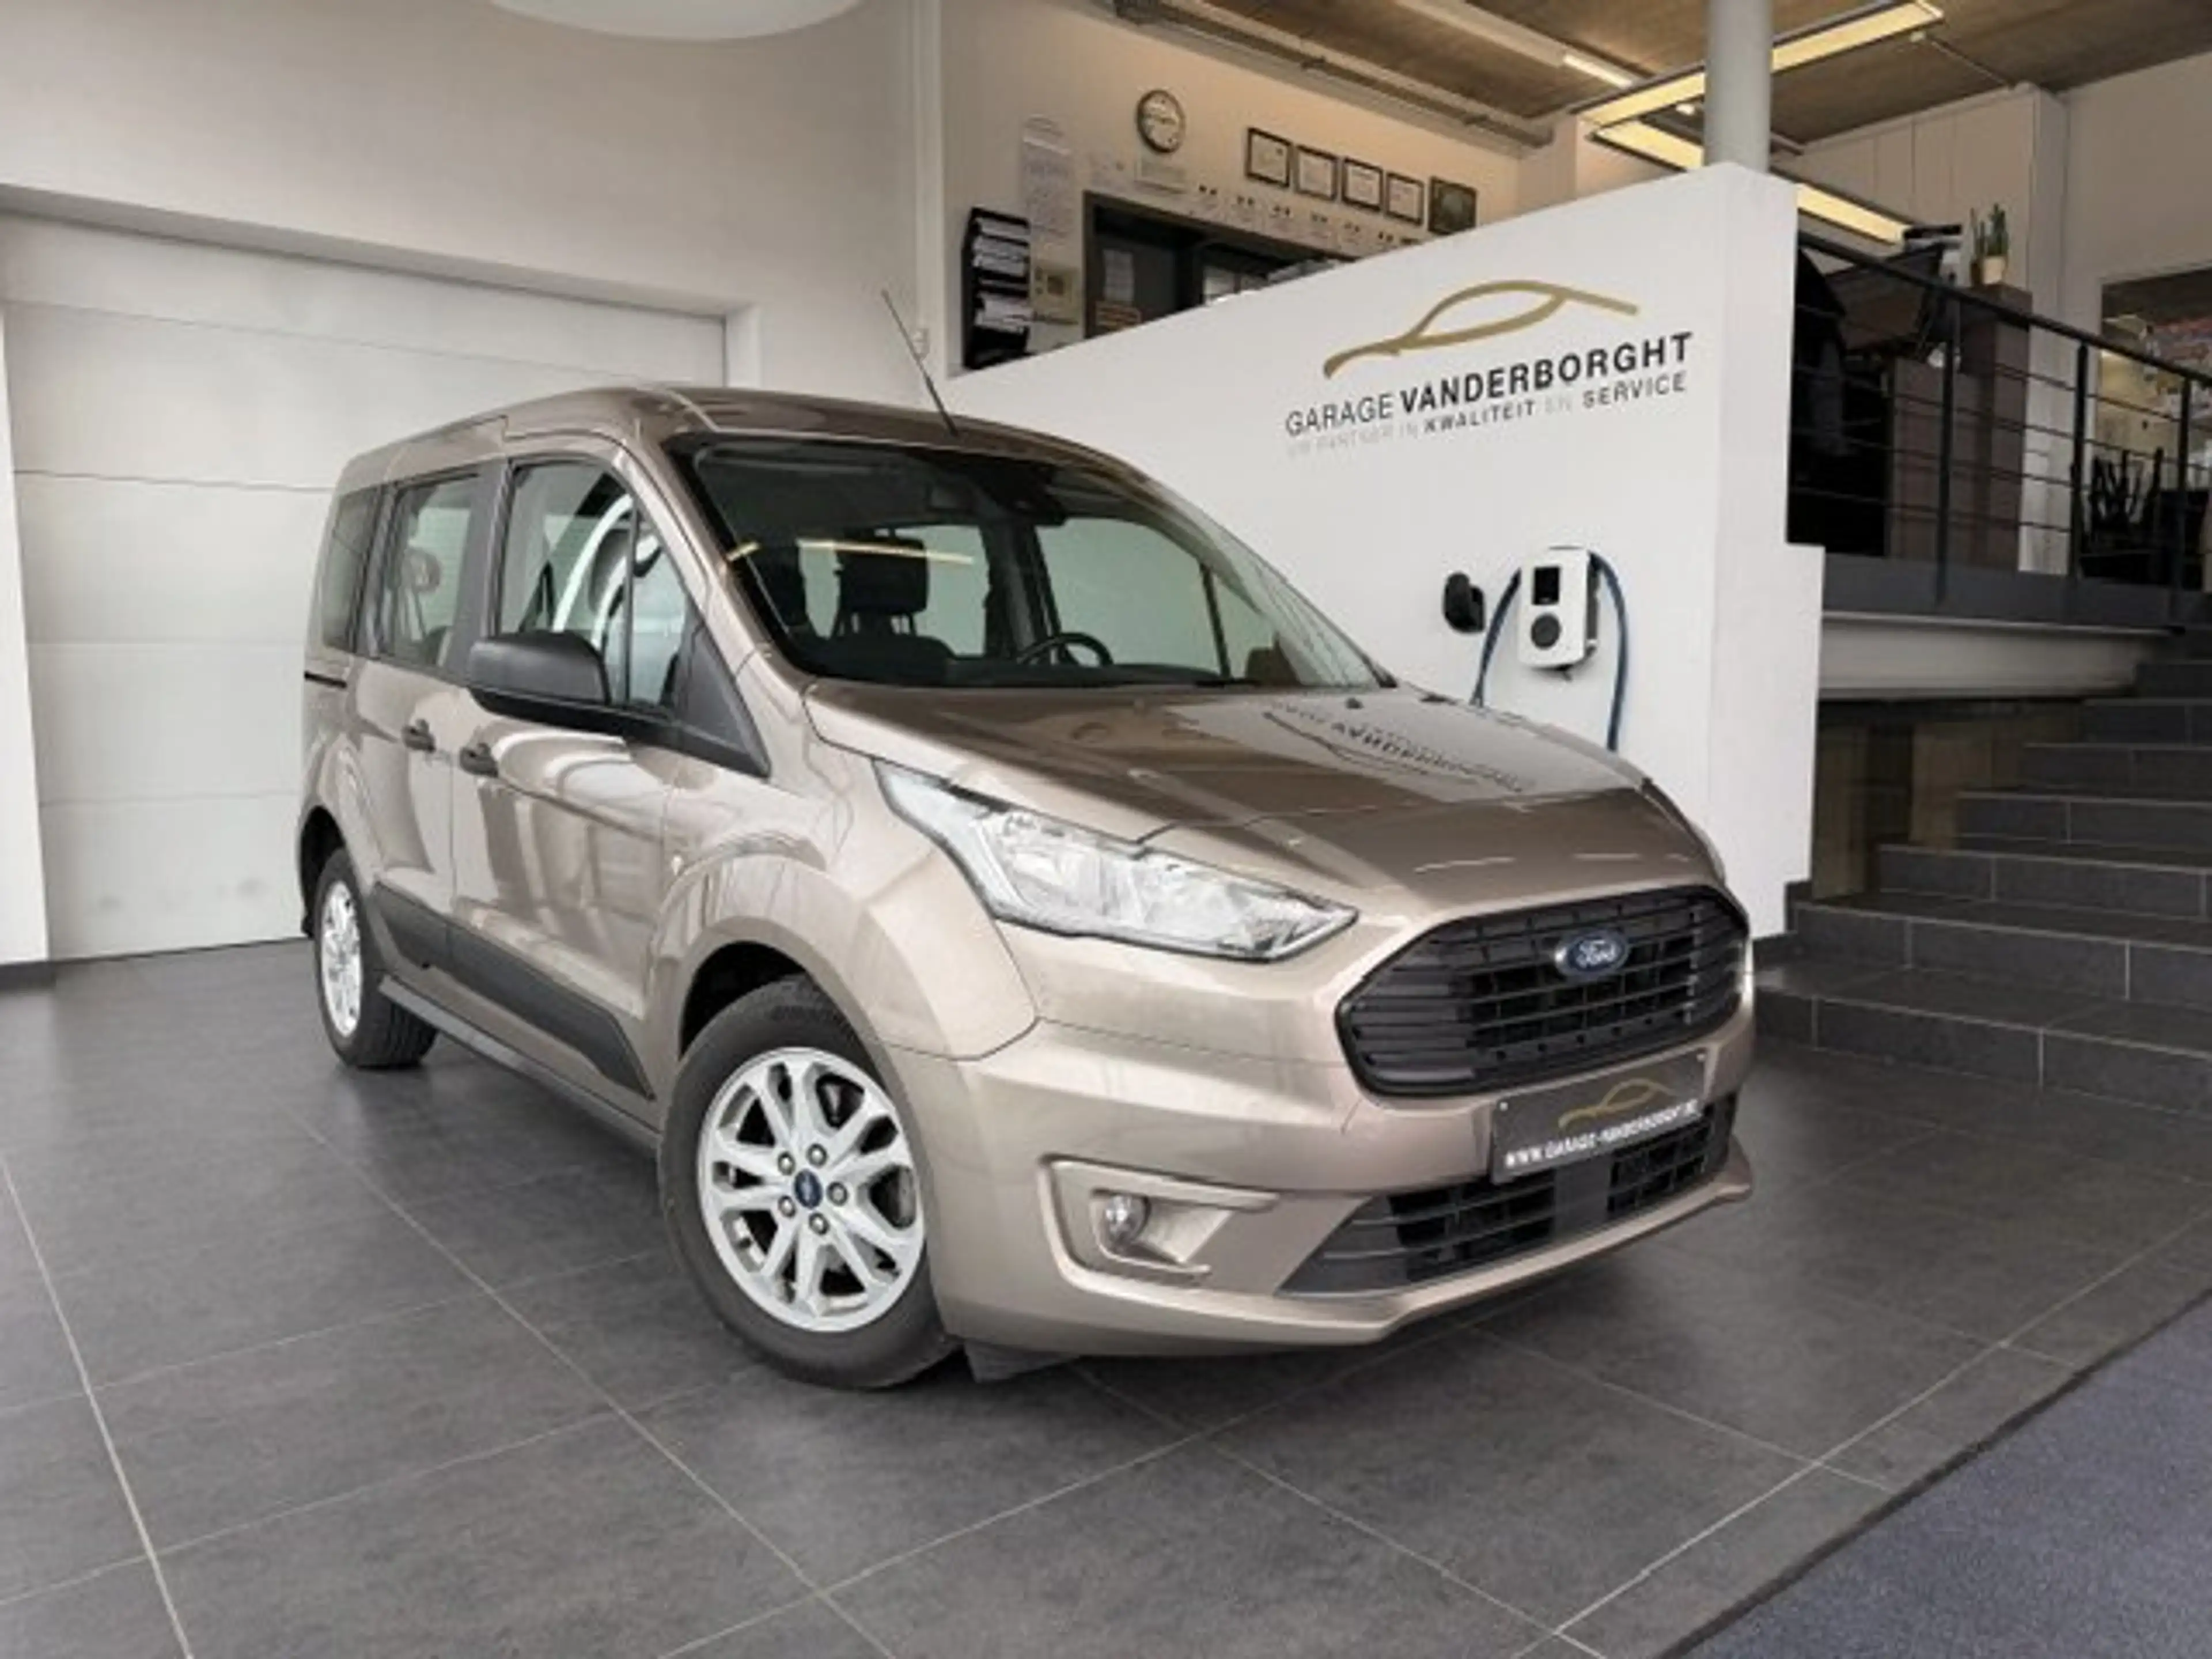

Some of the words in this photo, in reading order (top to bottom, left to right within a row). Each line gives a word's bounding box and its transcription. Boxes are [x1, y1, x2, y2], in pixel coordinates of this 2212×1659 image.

[1285, 392, 1394, 437] GARAGE
[1399, 330, 1693, 414] VANDERBORGHT
[1424, 399, 1536, 433] KWALITEIT
[1582, 370, 1687, 410] SERVICE
[1575, 938, 1616, 968] Ford
